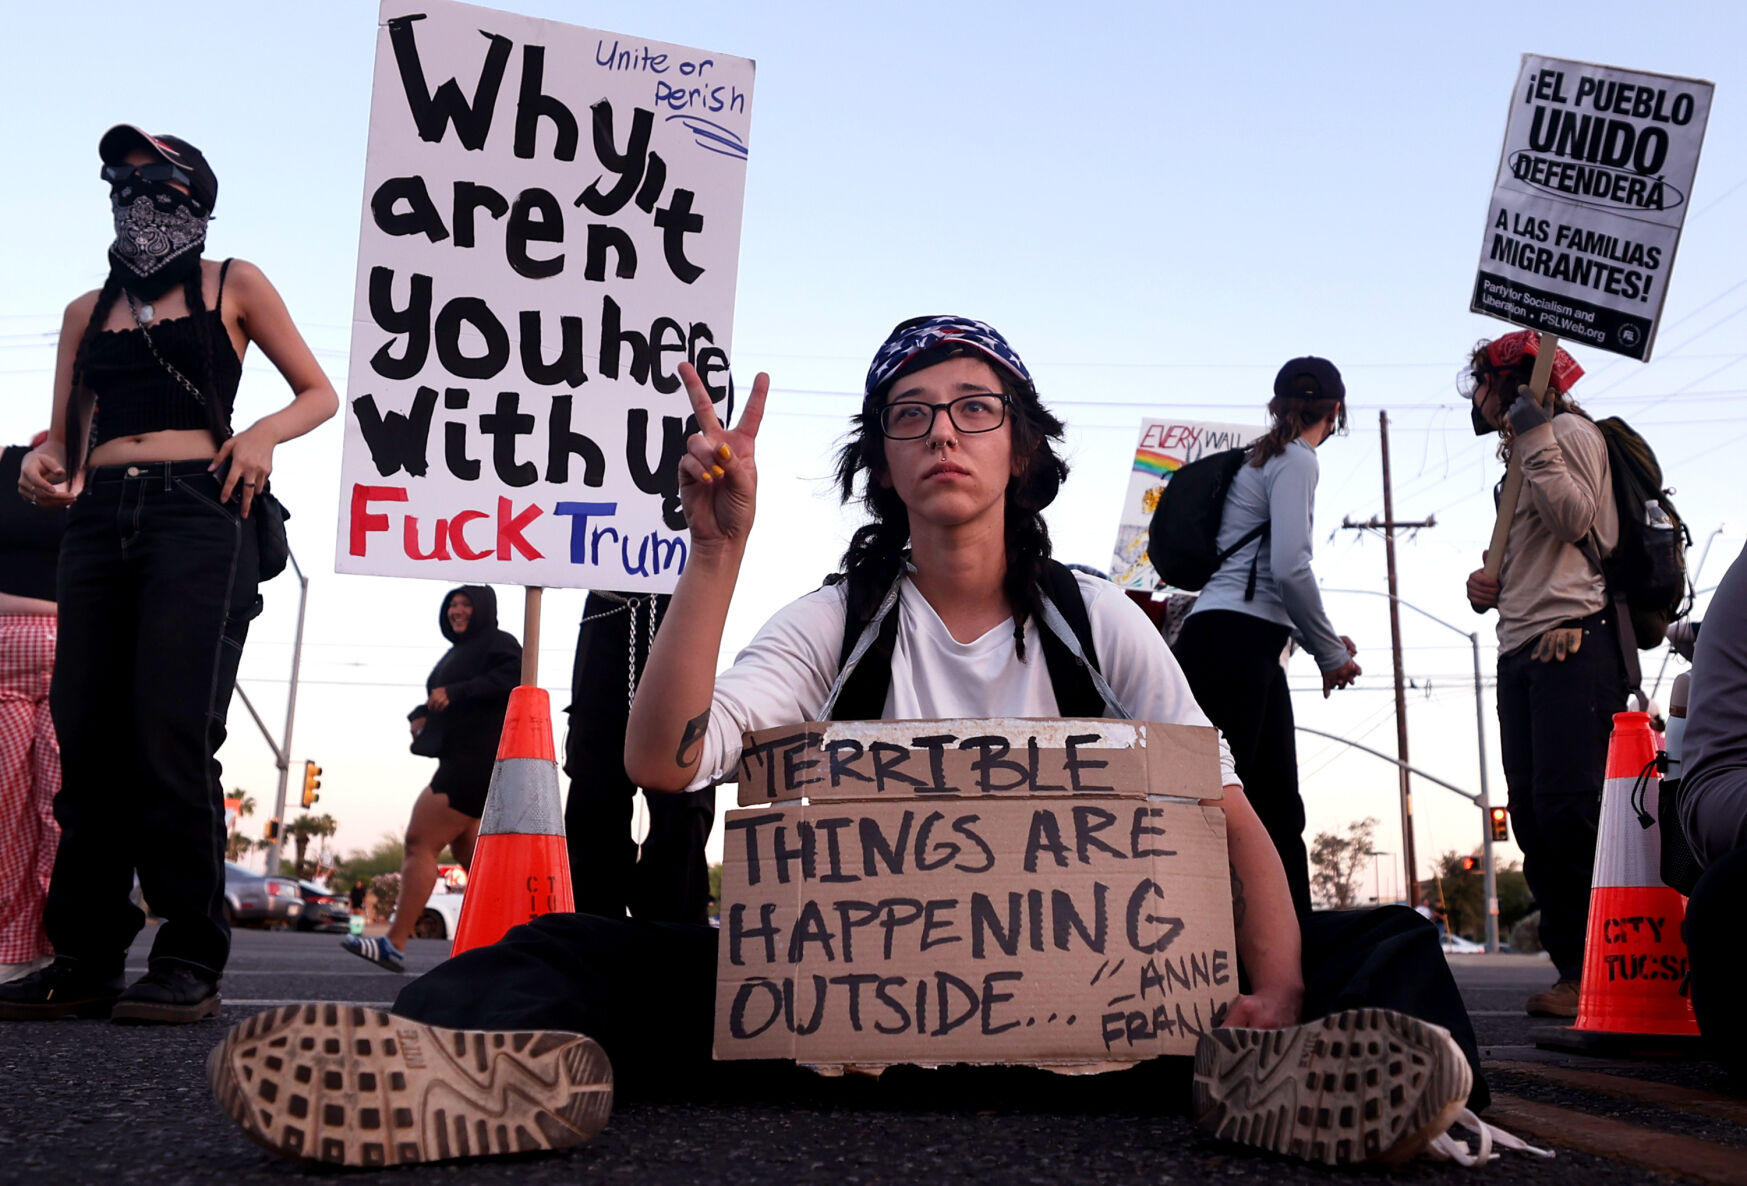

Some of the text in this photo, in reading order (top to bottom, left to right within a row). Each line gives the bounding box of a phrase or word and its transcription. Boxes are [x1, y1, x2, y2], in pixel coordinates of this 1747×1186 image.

[596, 40, 714, 77] Unite or
[388, 13, 656, 216] Why
[1525, 69, 1695, 126] ¡EL PUEBLO
[1529, 105, 1669, 176] UNIDO
[1514, 152, 1665, 211] DEFENDERÁ
[1490, 234, 1653, 302] MIGRANTES!
[1494, 208, 1662, 270] A LAS FAMILIAS
[1482, 293, 1527, 317] Liberation
[1540, 312, 1606, 342] PSLWeb.org
[1483, 280, 1596, 323] Party for Socialism and
[369, 265, 730, 404] you here
[1140, 424, 1204, 449] EVERY
[553, 502, 687, 578] Trum
[726, 805, 1177, 886] THINGS ARE
[729, 877, 1184, 966] HAPPENING
